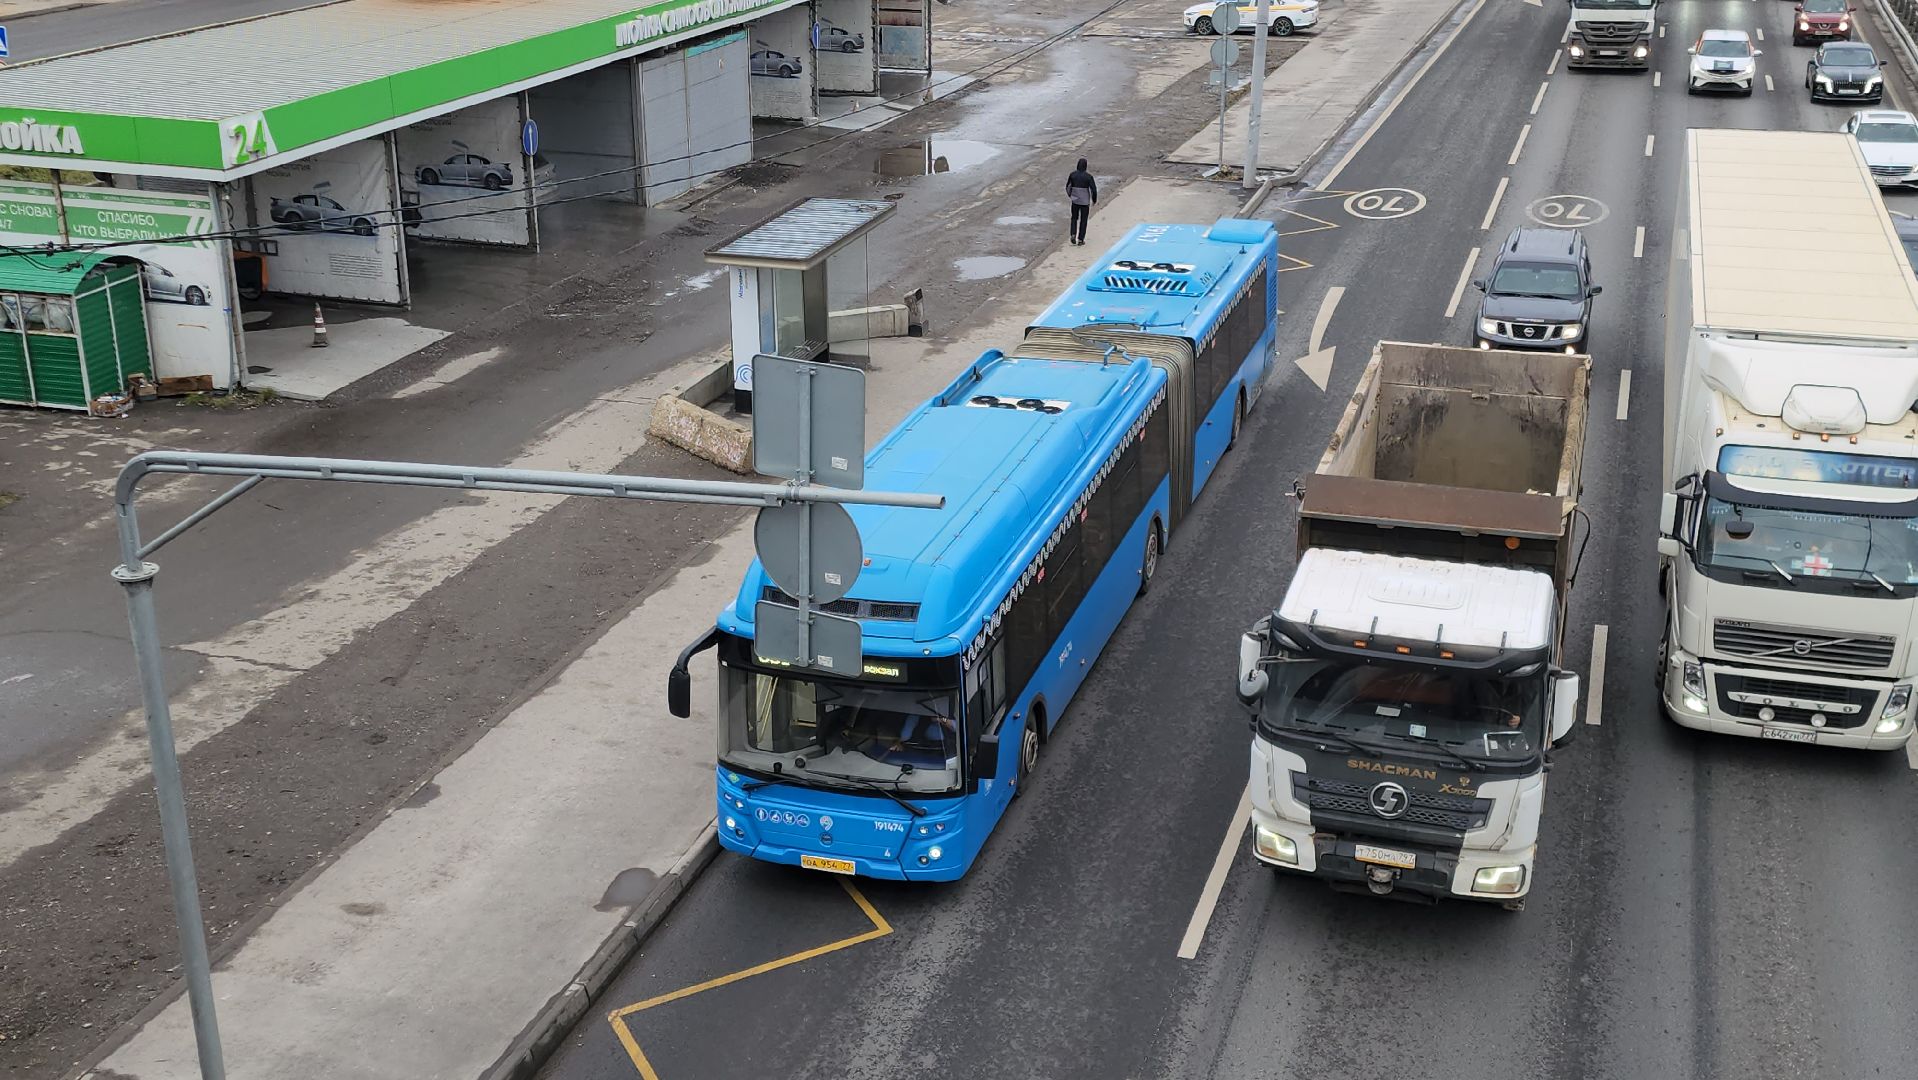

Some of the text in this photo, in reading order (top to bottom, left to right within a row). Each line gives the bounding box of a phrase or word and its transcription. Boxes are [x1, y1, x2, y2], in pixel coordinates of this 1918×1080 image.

[616, 14, 664, 46] МОЙКА
[0, 117, 84, 154] ОЙКА
[229, 119, 267, 165] 24
[10, 203, 53, 218] СНОВА!
[97, 210, 159, 228] СПАСИБО,
[73, 223, 97, 237] ЧТО
[100, 225, 157, 240] ВЫБРАЛИ
[1738, 694, 1854, 713] VOLVO
[1347, 759, 1438, 780] SHACMAN
[873, 820, 905, 833] 191474
